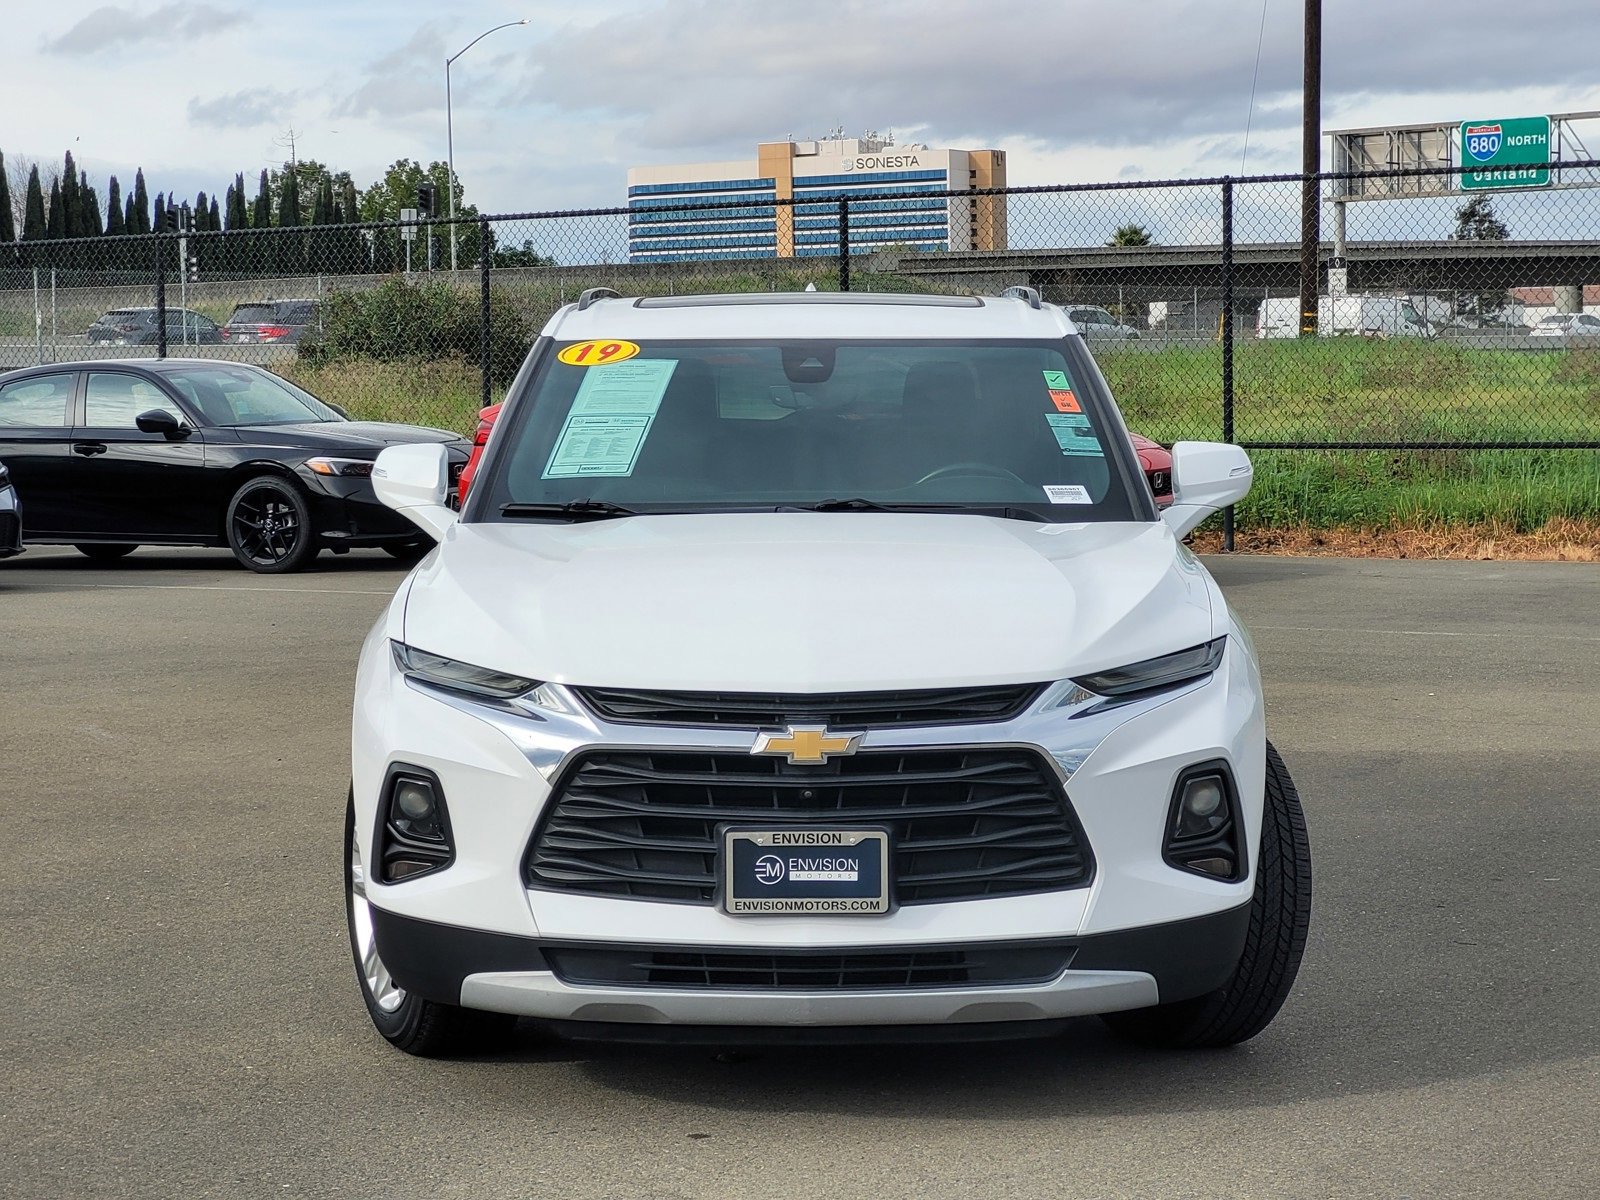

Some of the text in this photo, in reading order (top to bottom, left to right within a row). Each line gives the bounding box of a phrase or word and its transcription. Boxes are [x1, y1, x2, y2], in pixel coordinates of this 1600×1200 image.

[1470, 134, 1546, 153] 880 NORTH
[856, 155, 920, 169] SONESTA
[575, 343, 622, 362] 19
[772, 833, 842, 844] ENVISION
[789, 858, 859, 871] ENVISION
[734, 901, 880, 911] ENVISIONMOTORS.COM
